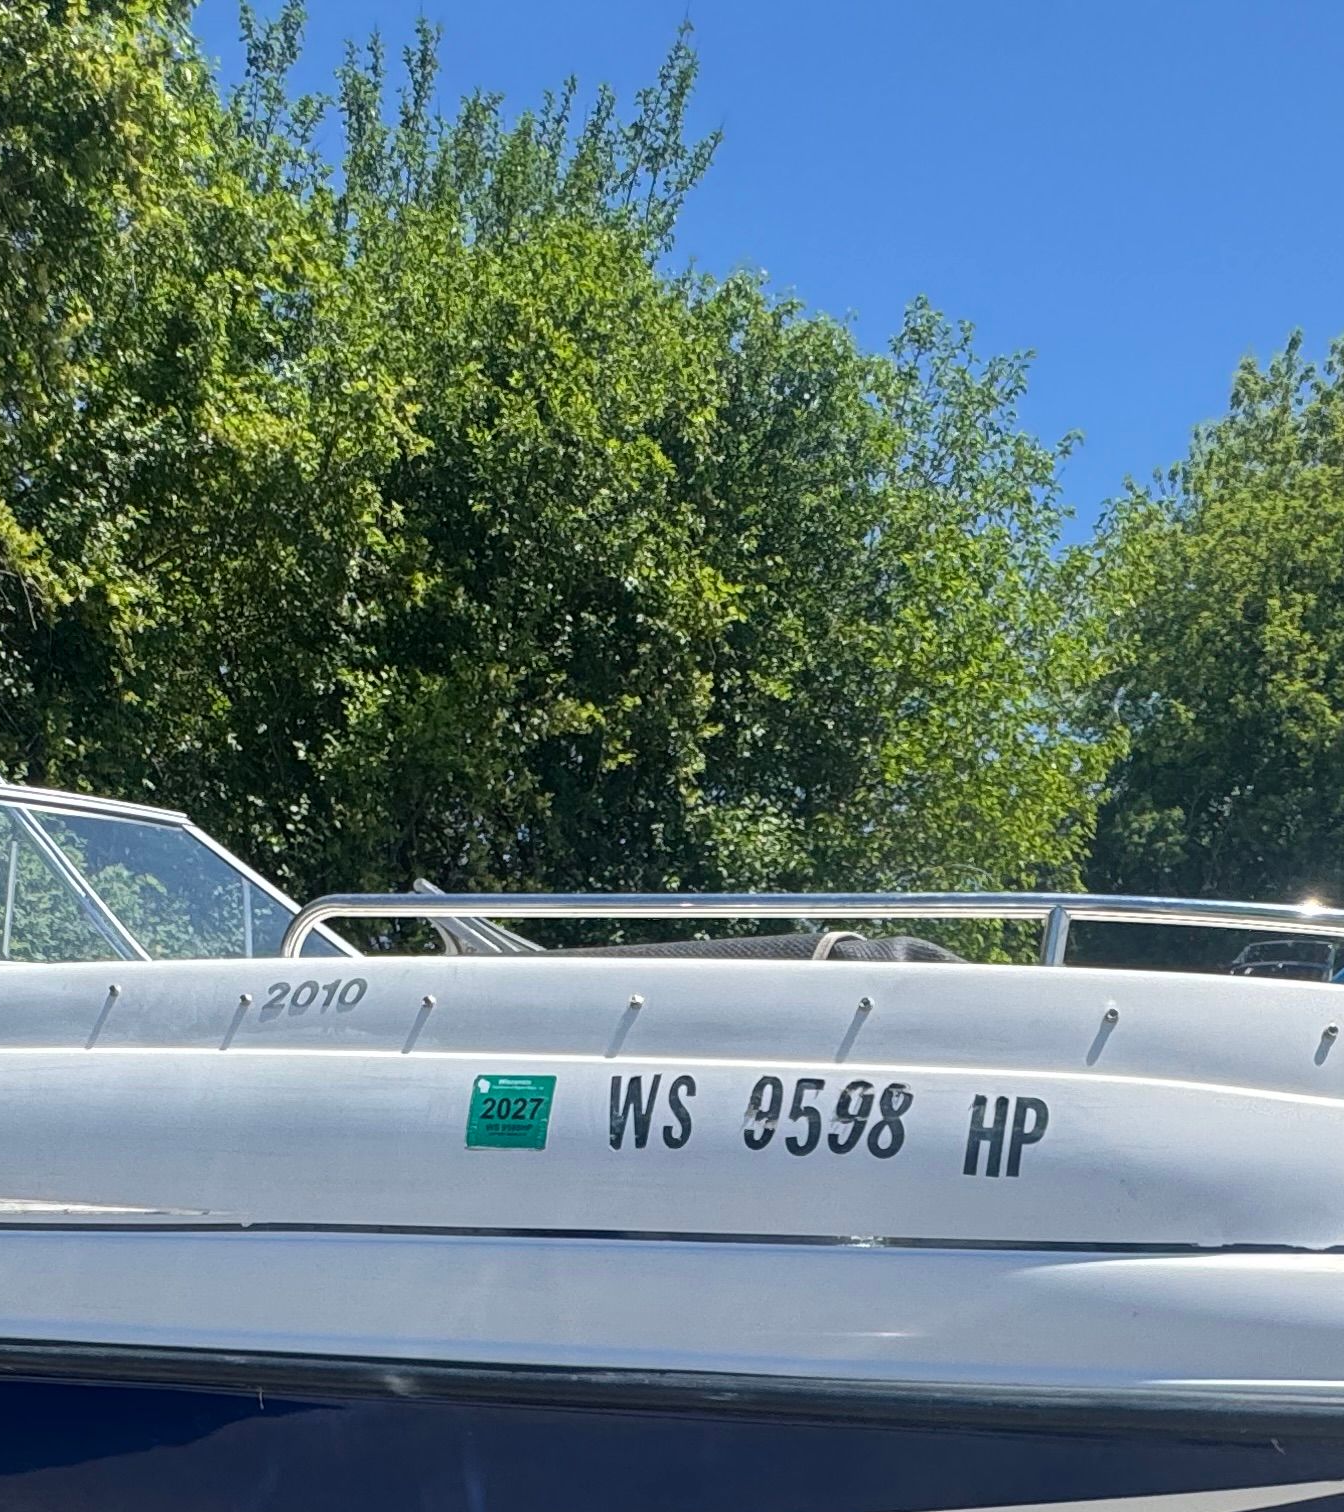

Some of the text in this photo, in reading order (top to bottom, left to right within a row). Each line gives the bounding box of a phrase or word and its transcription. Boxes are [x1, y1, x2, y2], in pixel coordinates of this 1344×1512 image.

[261, 977, 368, 1011] 2010
[479, 1097, 545, 1120] 2027
[608, 1073, 1050, 1178] WS 9598 HP
